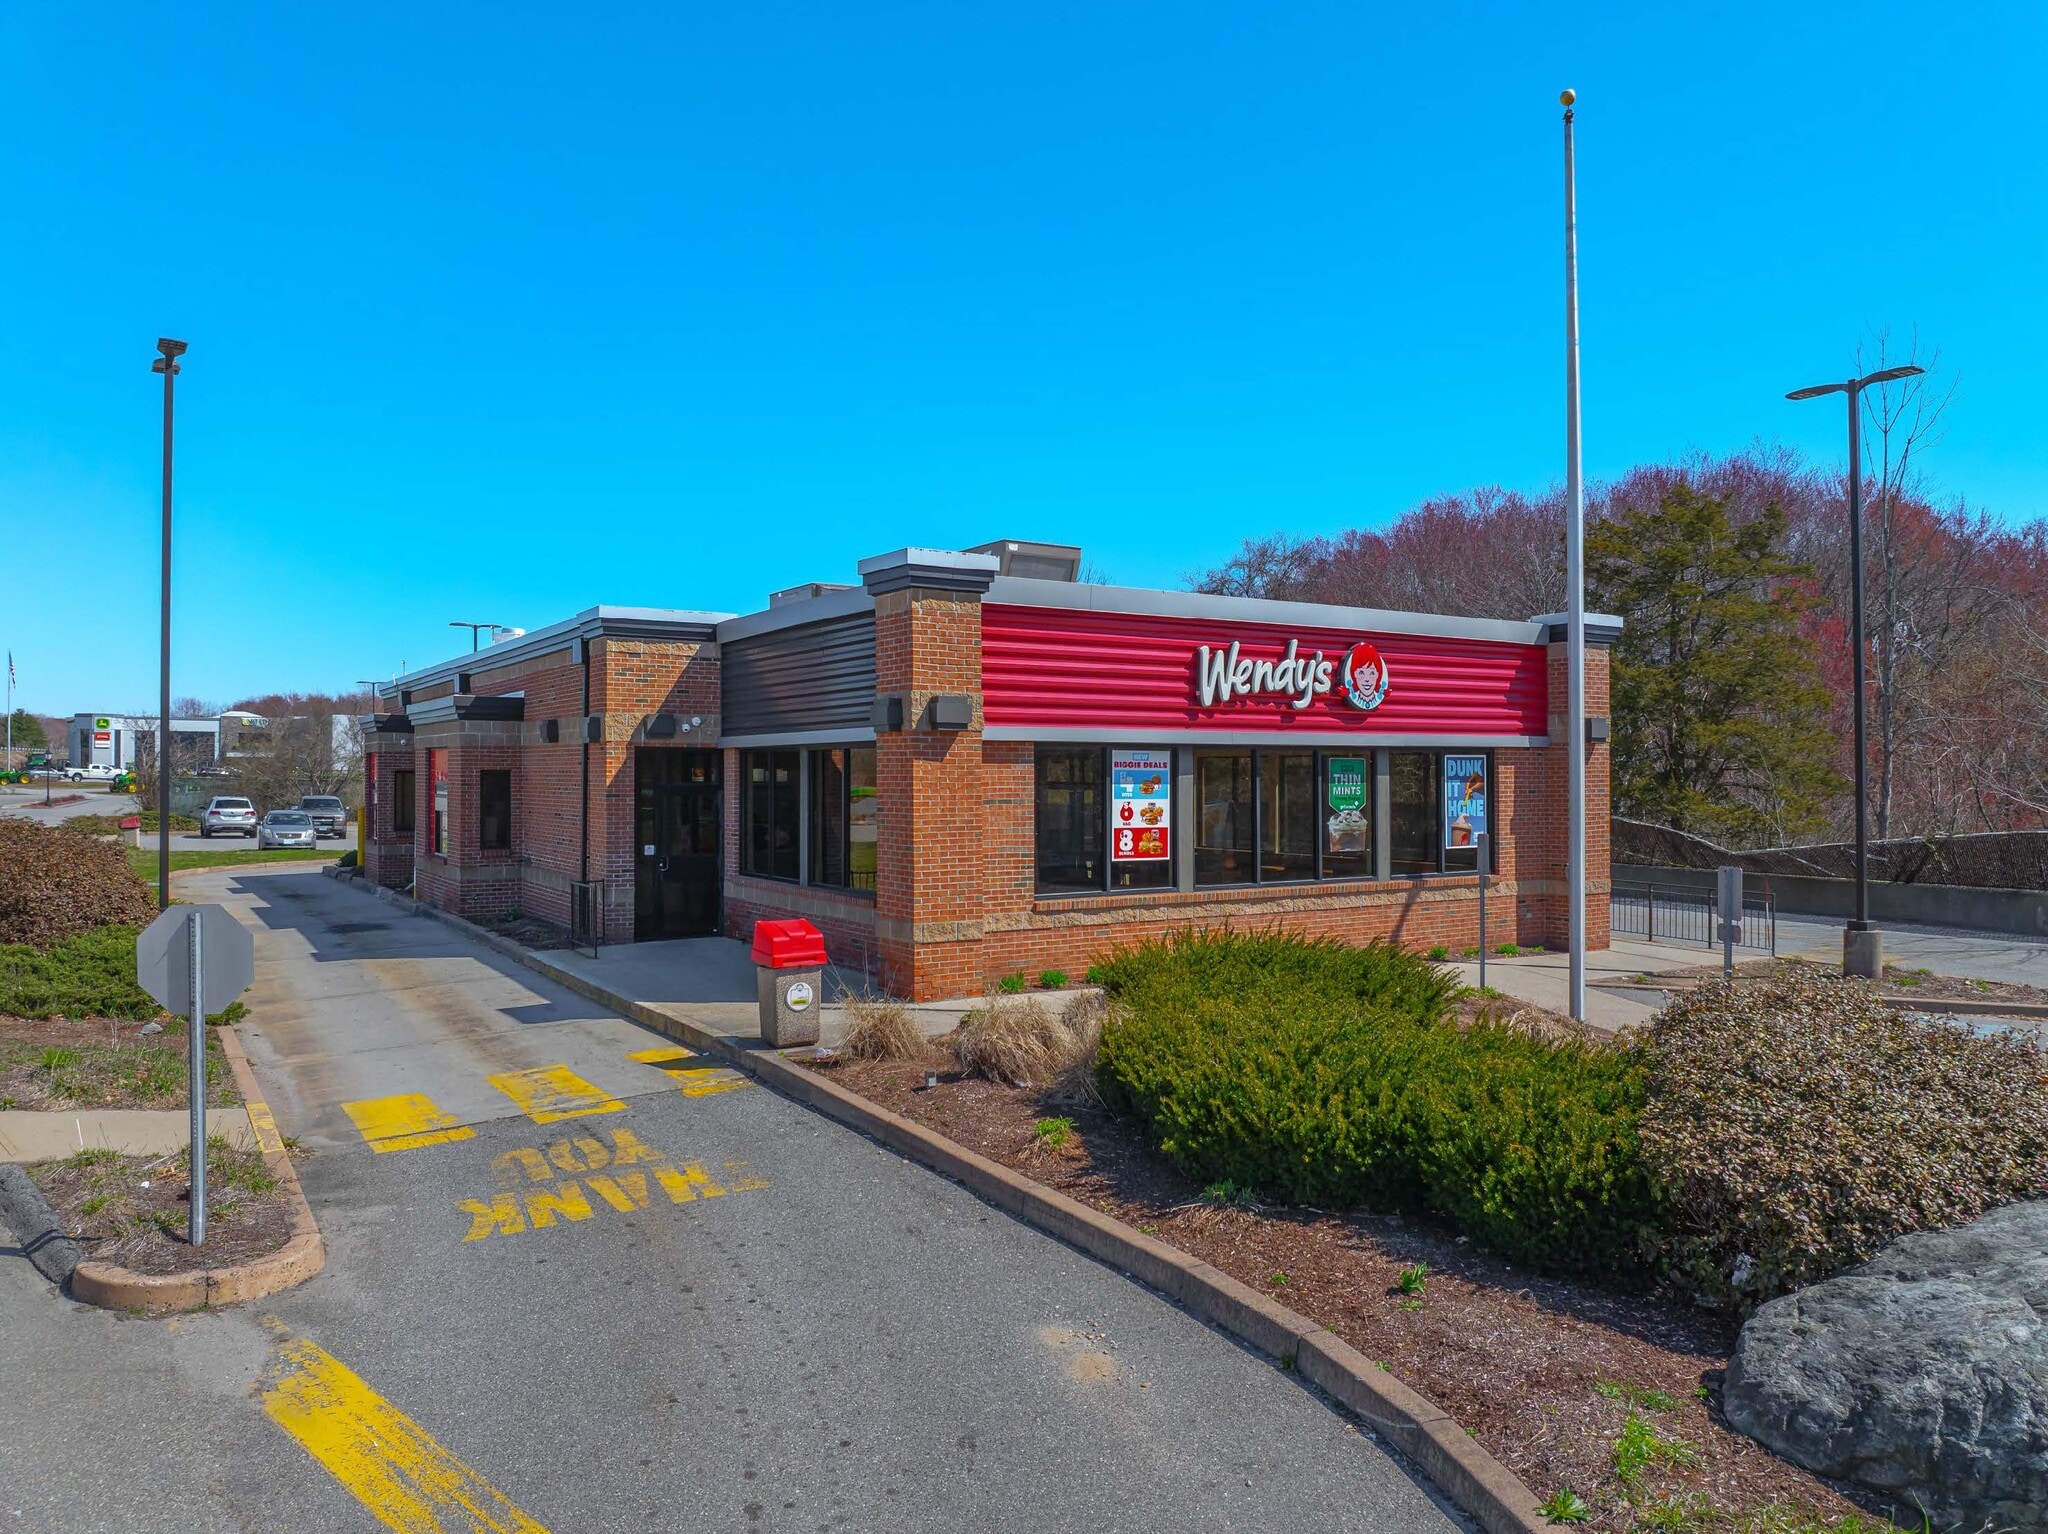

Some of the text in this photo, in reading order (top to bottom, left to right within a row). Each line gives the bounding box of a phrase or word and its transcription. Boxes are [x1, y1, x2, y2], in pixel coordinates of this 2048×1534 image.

[1197, 638, 1333, 710] Wendy's
[1113, 761, 1168, 769] BIGGIE DEALS
[1447, 759, 1483, 777] DUNK
[1333, 773, 1362, 785] THIN
[1333, 786, 1362, 796] MINTS
[1447, 779, 1461, 798] IT
[1447, 799, 1485, 817] HOME
[488, 1127, 666, 1189] YOU
